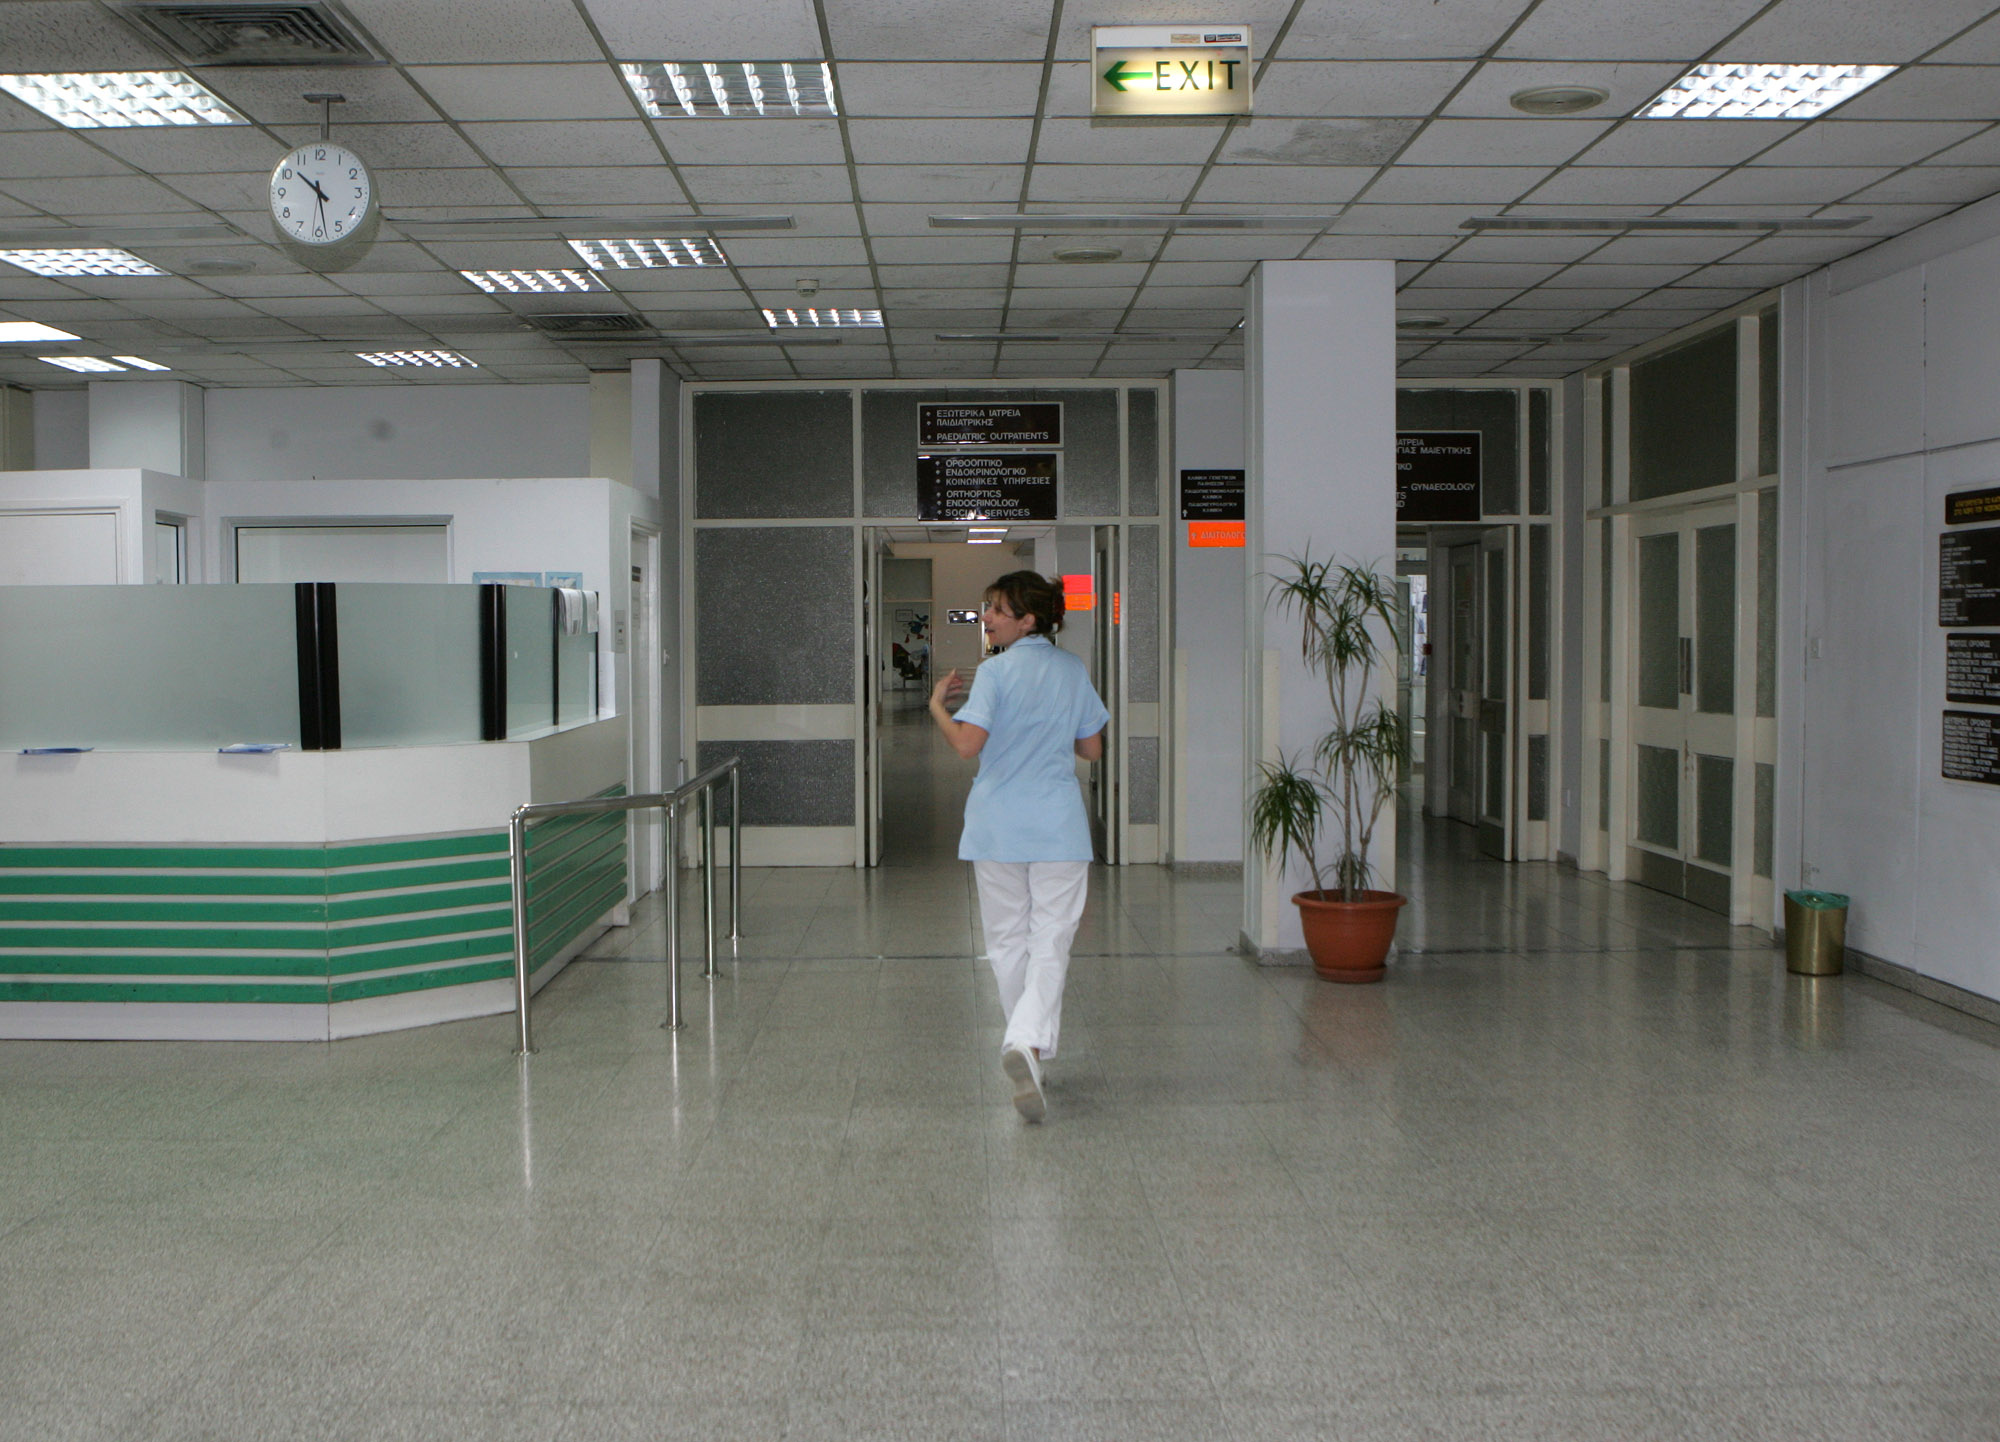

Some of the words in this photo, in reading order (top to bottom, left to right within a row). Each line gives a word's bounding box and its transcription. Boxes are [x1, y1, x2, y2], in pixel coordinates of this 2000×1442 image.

[1155, 60, 1241, 91] EXIT
[297, 153, 306, 166] 11
[315, 149, 326, 161] 12
[281, 168, 293, 180] 10
[348, 167, 358, 180] 2
[277, 187, 287, 199] 9
[354, 187, 363, 199] 3
[282, 207, 291, 218] 8
[296, 221, 304, 232] 7
[334, 220, 343, 232] 5
[314, 226, 323, 238] 6
[936, 409, 985, 417] ΕΞΩΤΕΡΙΚΑ
[989, 409, 1021, 417] ΙΑΤΡΕΙΑ
[936, 418, 994, 426] ΠΑΙΔΙΑΤΡΙΚΗΣ
[936, 432, 986, 441] PAEDIATRIC
[990, 431, 1049, 440] OUTPATIENTS
[1420, 446, 1472, 455] ΜΑΙΕΥΤΙΚΗΣ
[945, 467, 1026, 476] ΕΝΔΟΚΡΙΝΟΛΟΓΙΚΟ
[946, 477, 998, 485] ΚΟΙΝΩΝΙΚΕΣ
[1003, 476, 1050, 485] ΥΠΗΡΕΣΙΕΣ
[1410, 483, 1476, 491] GYNAECOLOGY
[946, 490, 1002, 498] ORTHOPTICS
[946, 499, 1020, 507] ENDOCRINOLOGY
[984, 508, 1030, 517] SERVICES
